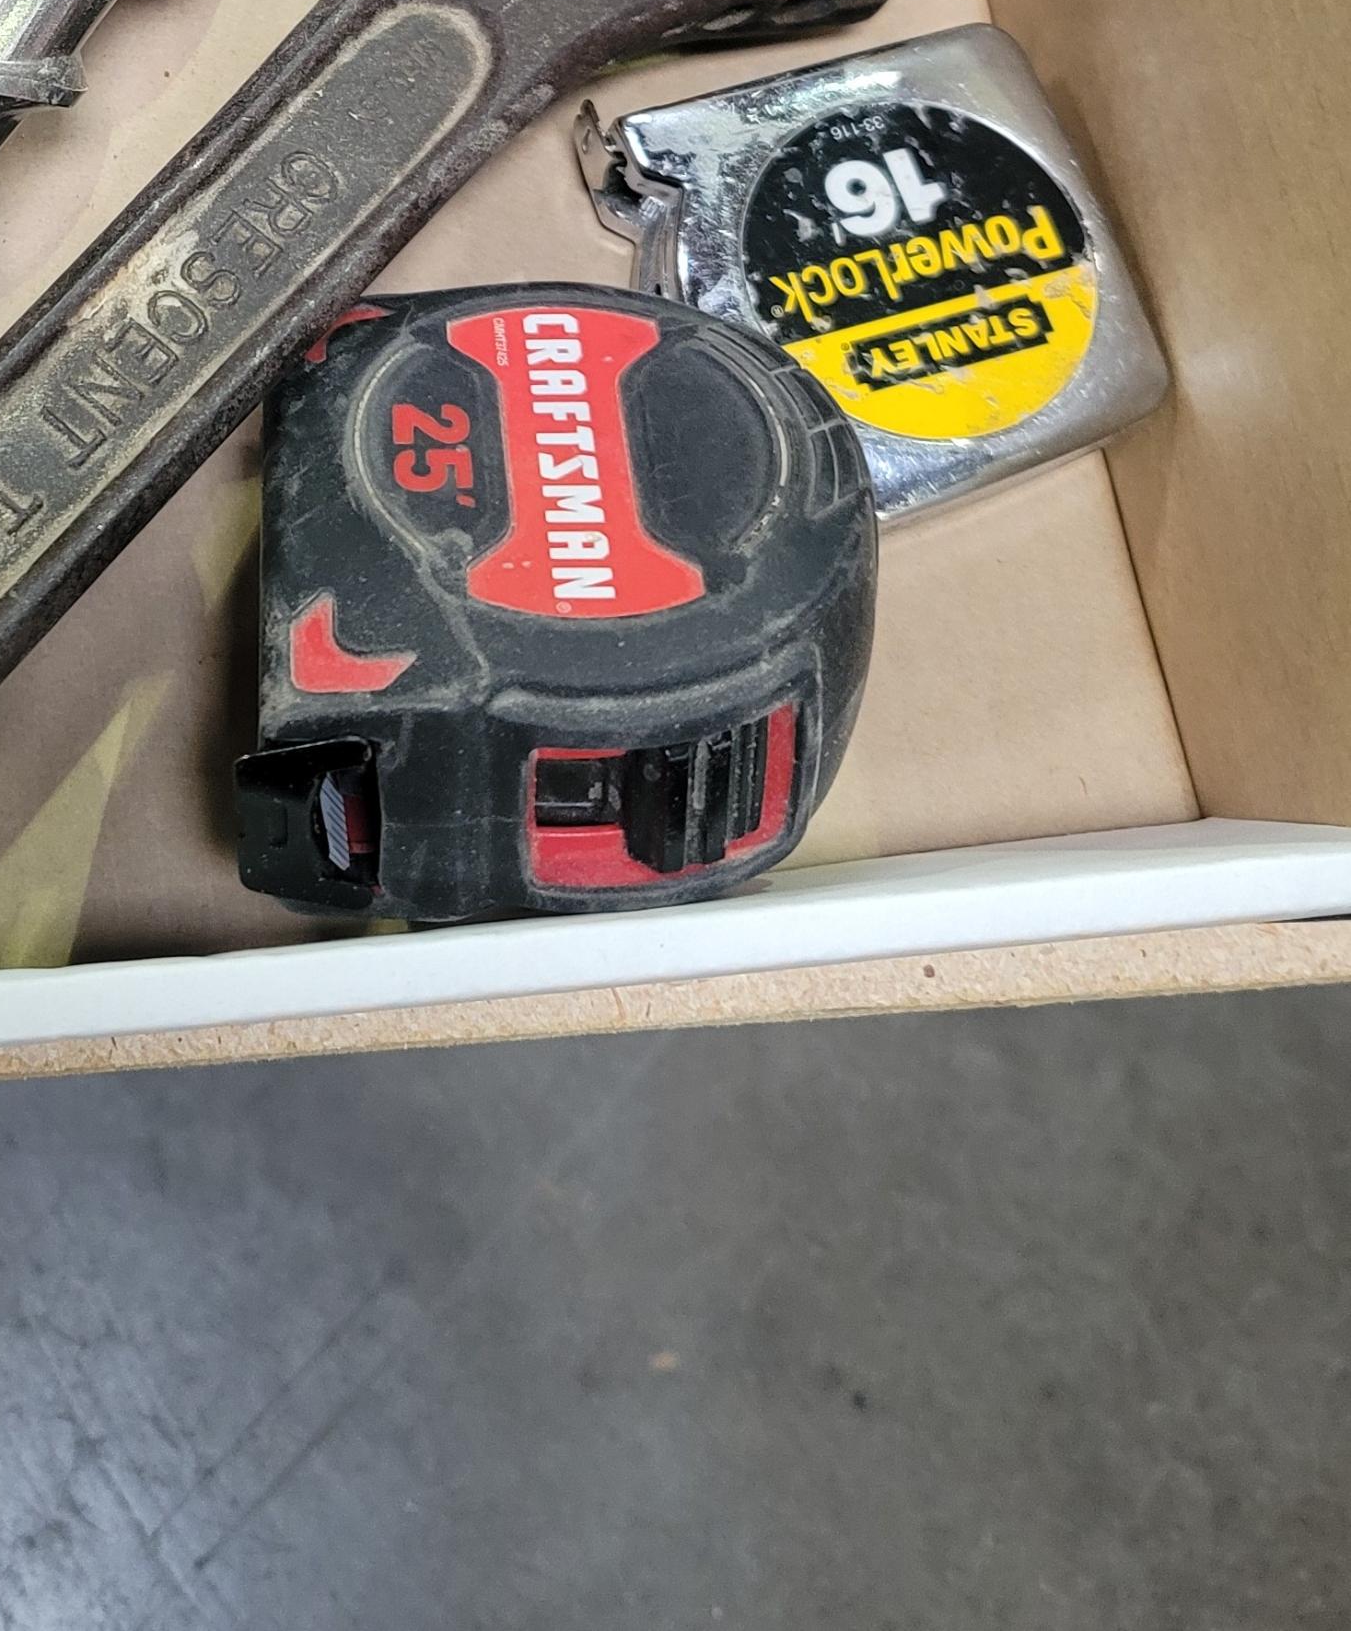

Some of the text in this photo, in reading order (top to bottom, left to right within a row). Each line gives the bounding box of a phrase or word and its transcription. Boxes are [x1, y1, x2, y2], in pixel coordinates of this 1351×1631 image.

[830, 115, 885, 141] 33-116
[43, 149, 346, 473] CRESCENT
[767, 205, 1065, 323] PowerLock
[868, 307, 1039, 377] STANLEY
[522, 312, 616, 600] CRAFTSMAN
